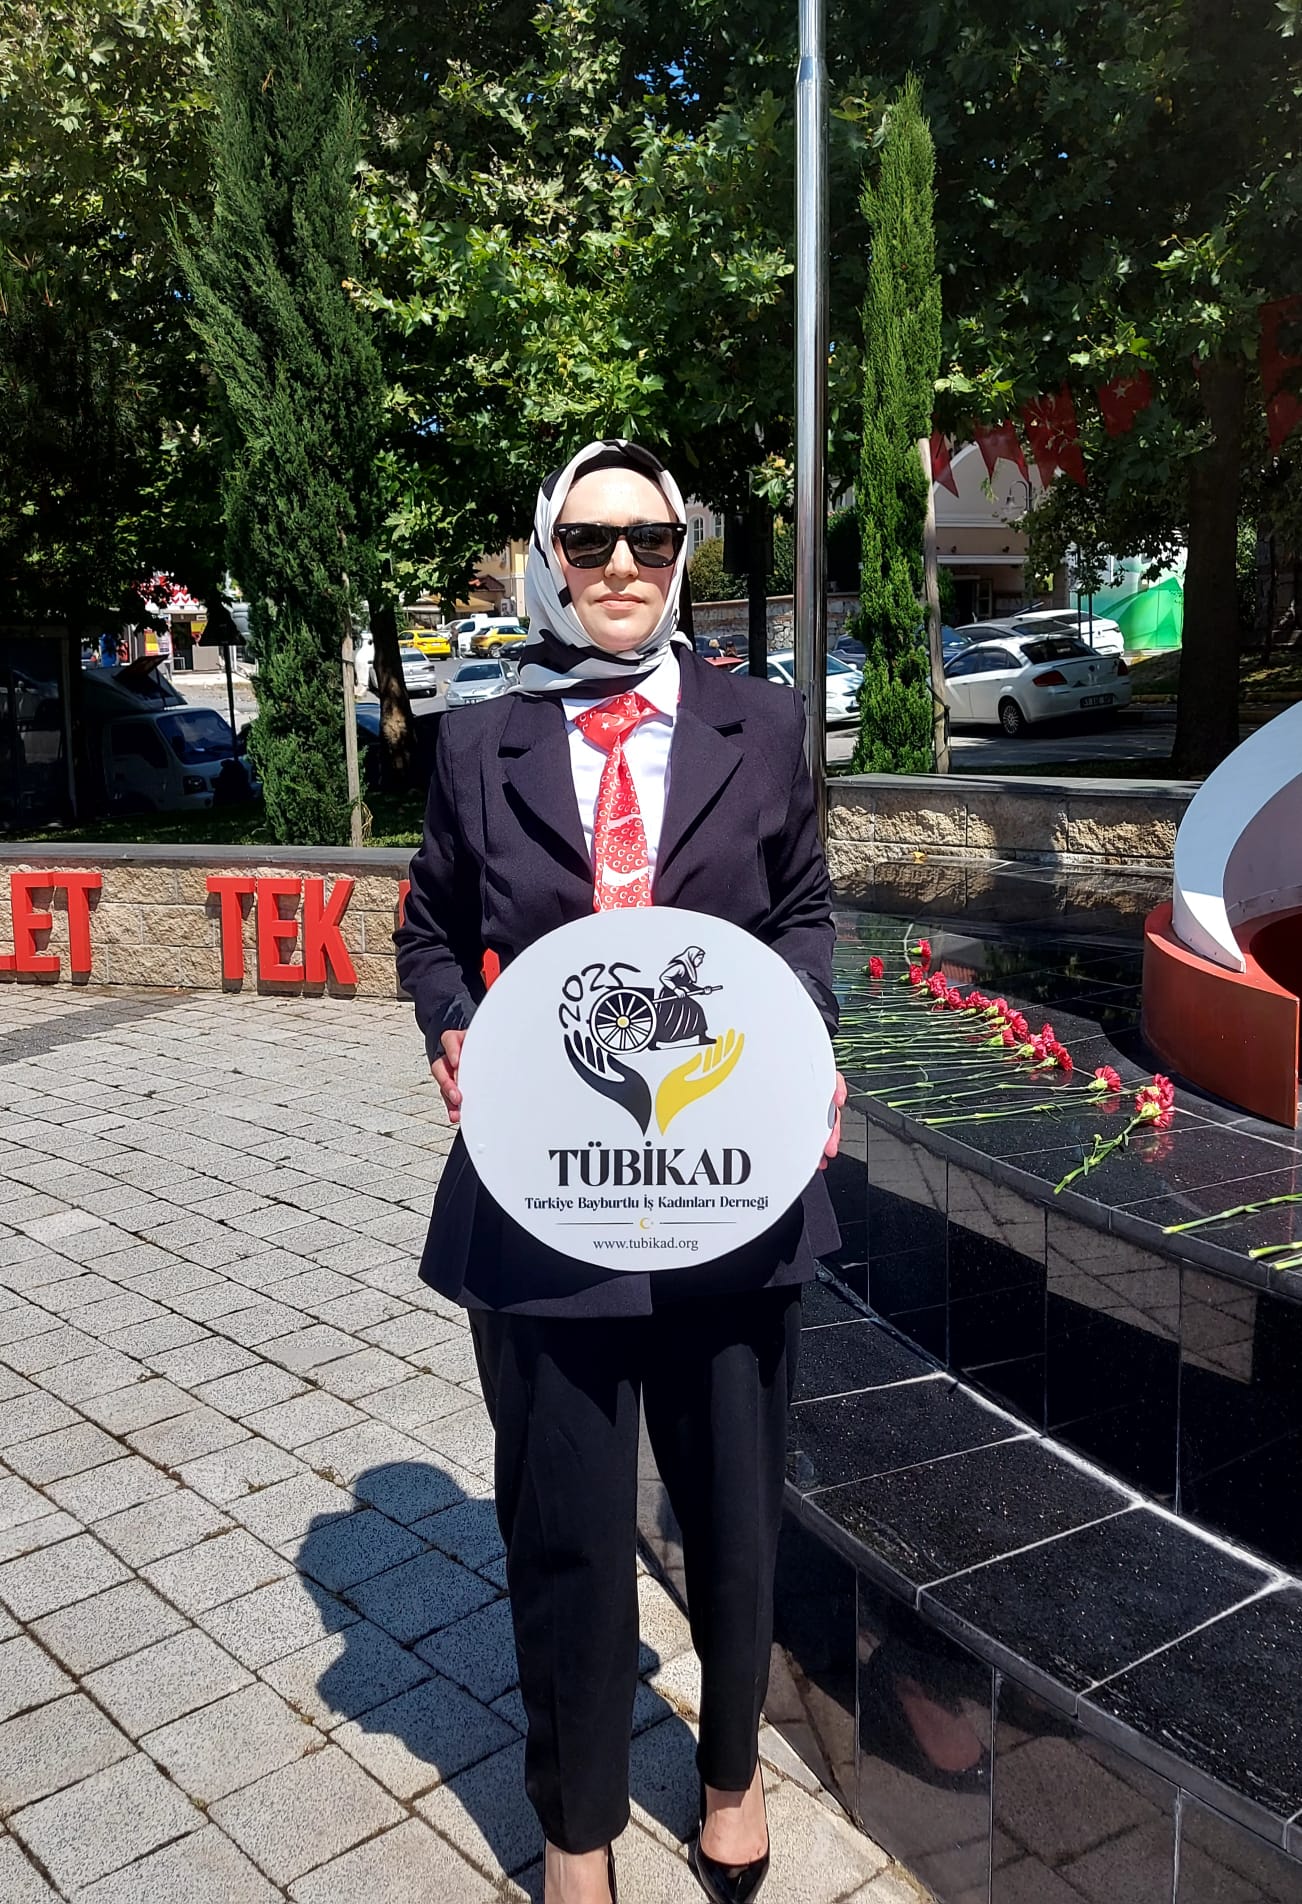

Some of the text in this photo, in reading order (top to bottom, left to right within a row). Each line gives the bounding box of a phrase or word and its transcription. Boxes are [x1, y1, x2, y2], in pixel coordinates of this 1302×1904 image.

[0, 872, 103, 973] ET
[206, 876, 358, 985] TEK
[548, 1140, 752, 1187] TÜBİKAD
[524, 1193, 769, 1212] Türkiye Bayburtlu İş Kadınları Derneği
[592, 1236, 700, 1252] www.tubikad.org
